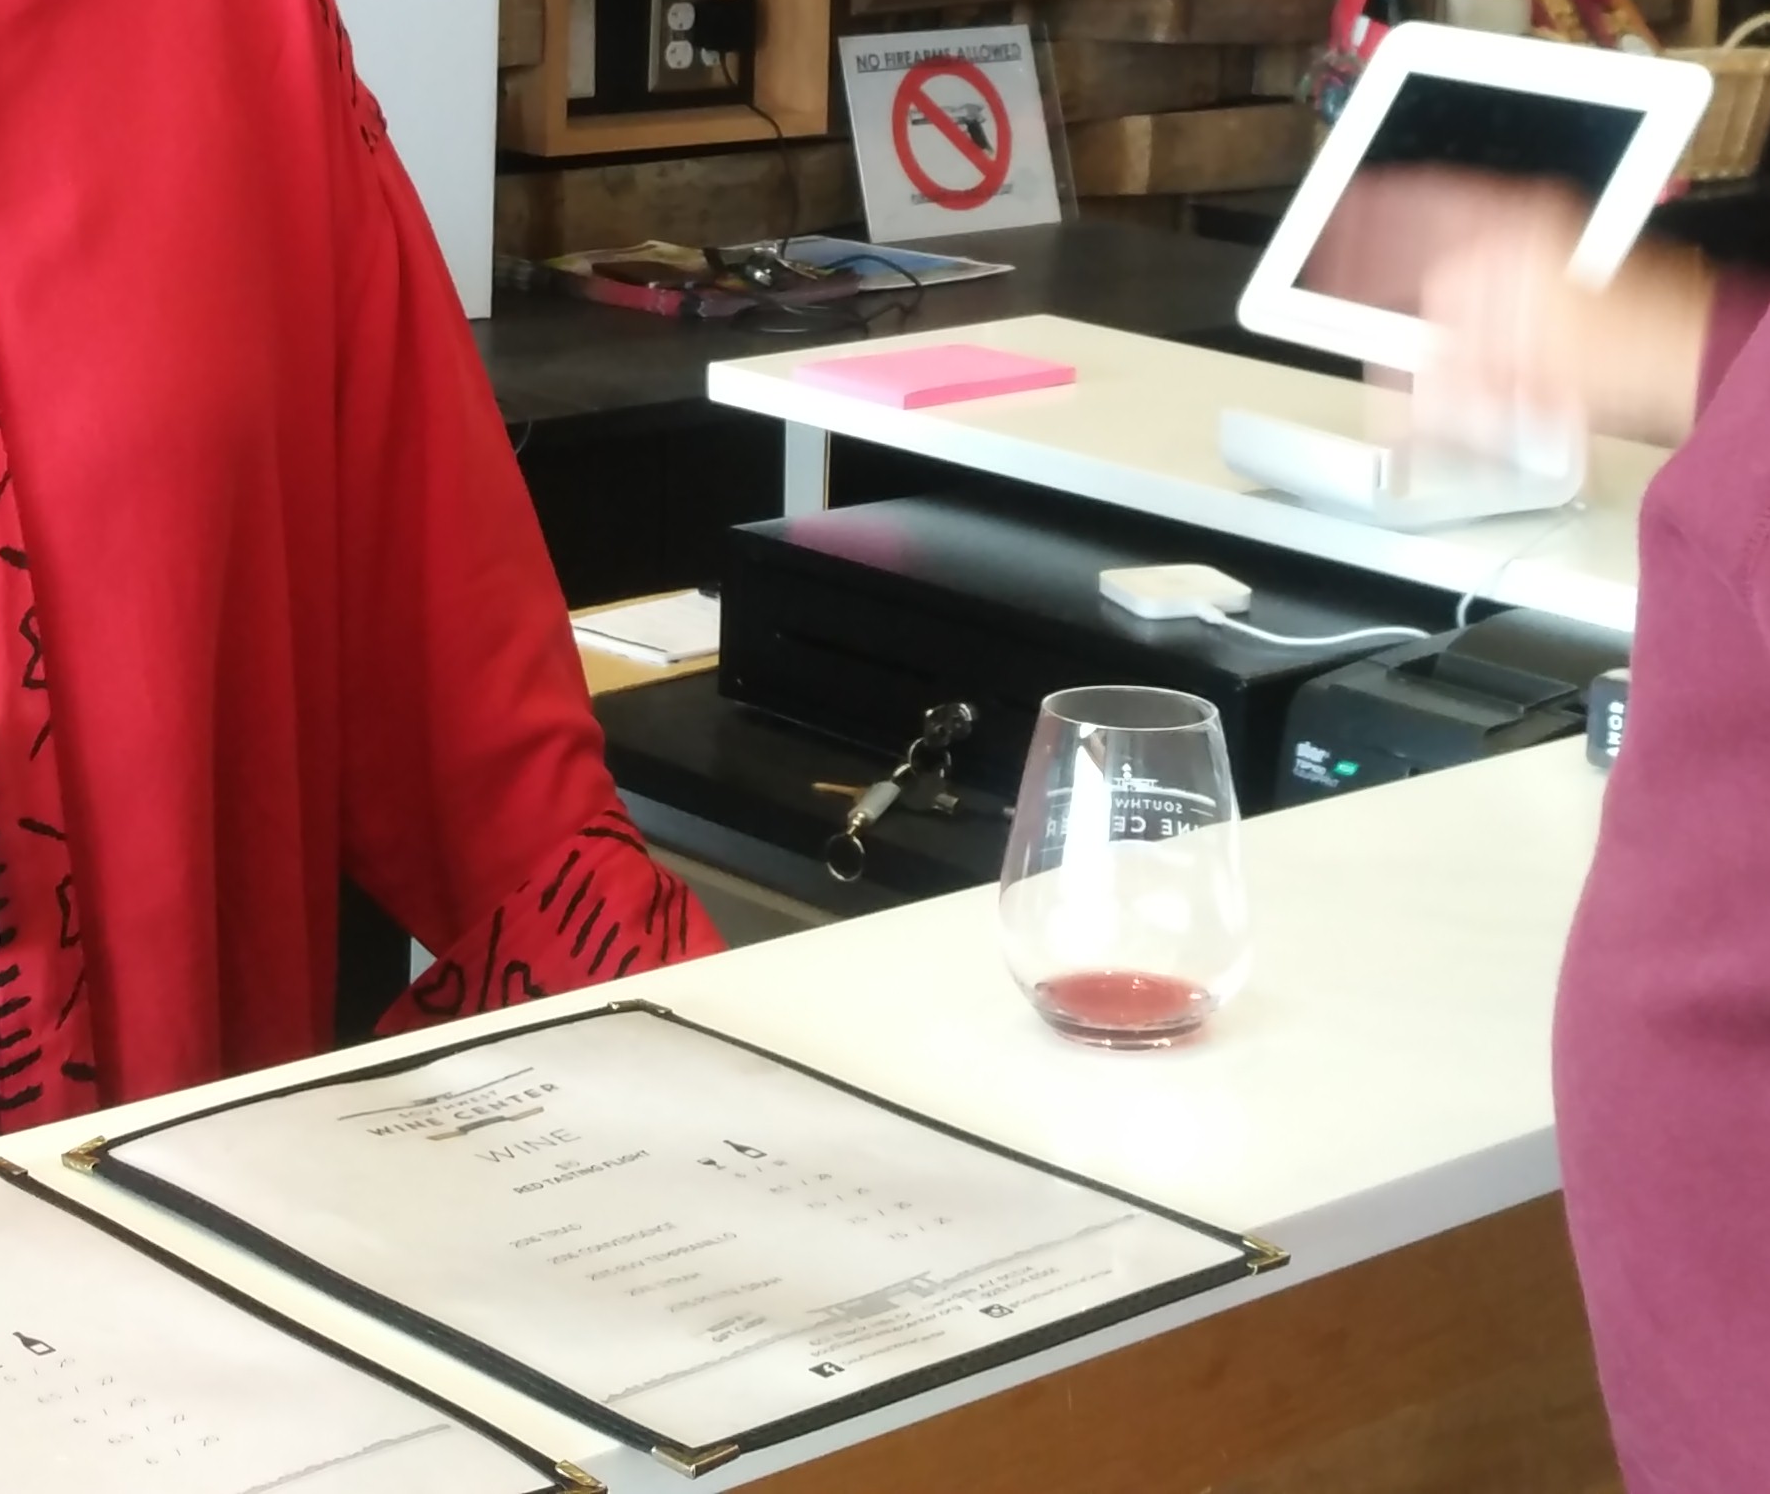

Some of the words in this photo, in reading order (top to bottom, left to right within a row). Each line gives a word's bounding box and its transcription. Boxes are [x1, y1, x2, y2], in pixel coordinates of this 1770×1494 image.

[856, 53, 880, 72] NO
[884, 47, 951, 68] FIREARMS
[957, 42, 1022, 63] ALLOWED
[366, 1117, 444, 1137] WINE
[453, 1082, 561, 1120] CENTER
[475, 1127, 582, 1164] WINE
[512, 1181, 544, 1195] RED
[543, 1164, 604, 1187] TASTING
[602, 1148, 652, 1171] FLIGHT
